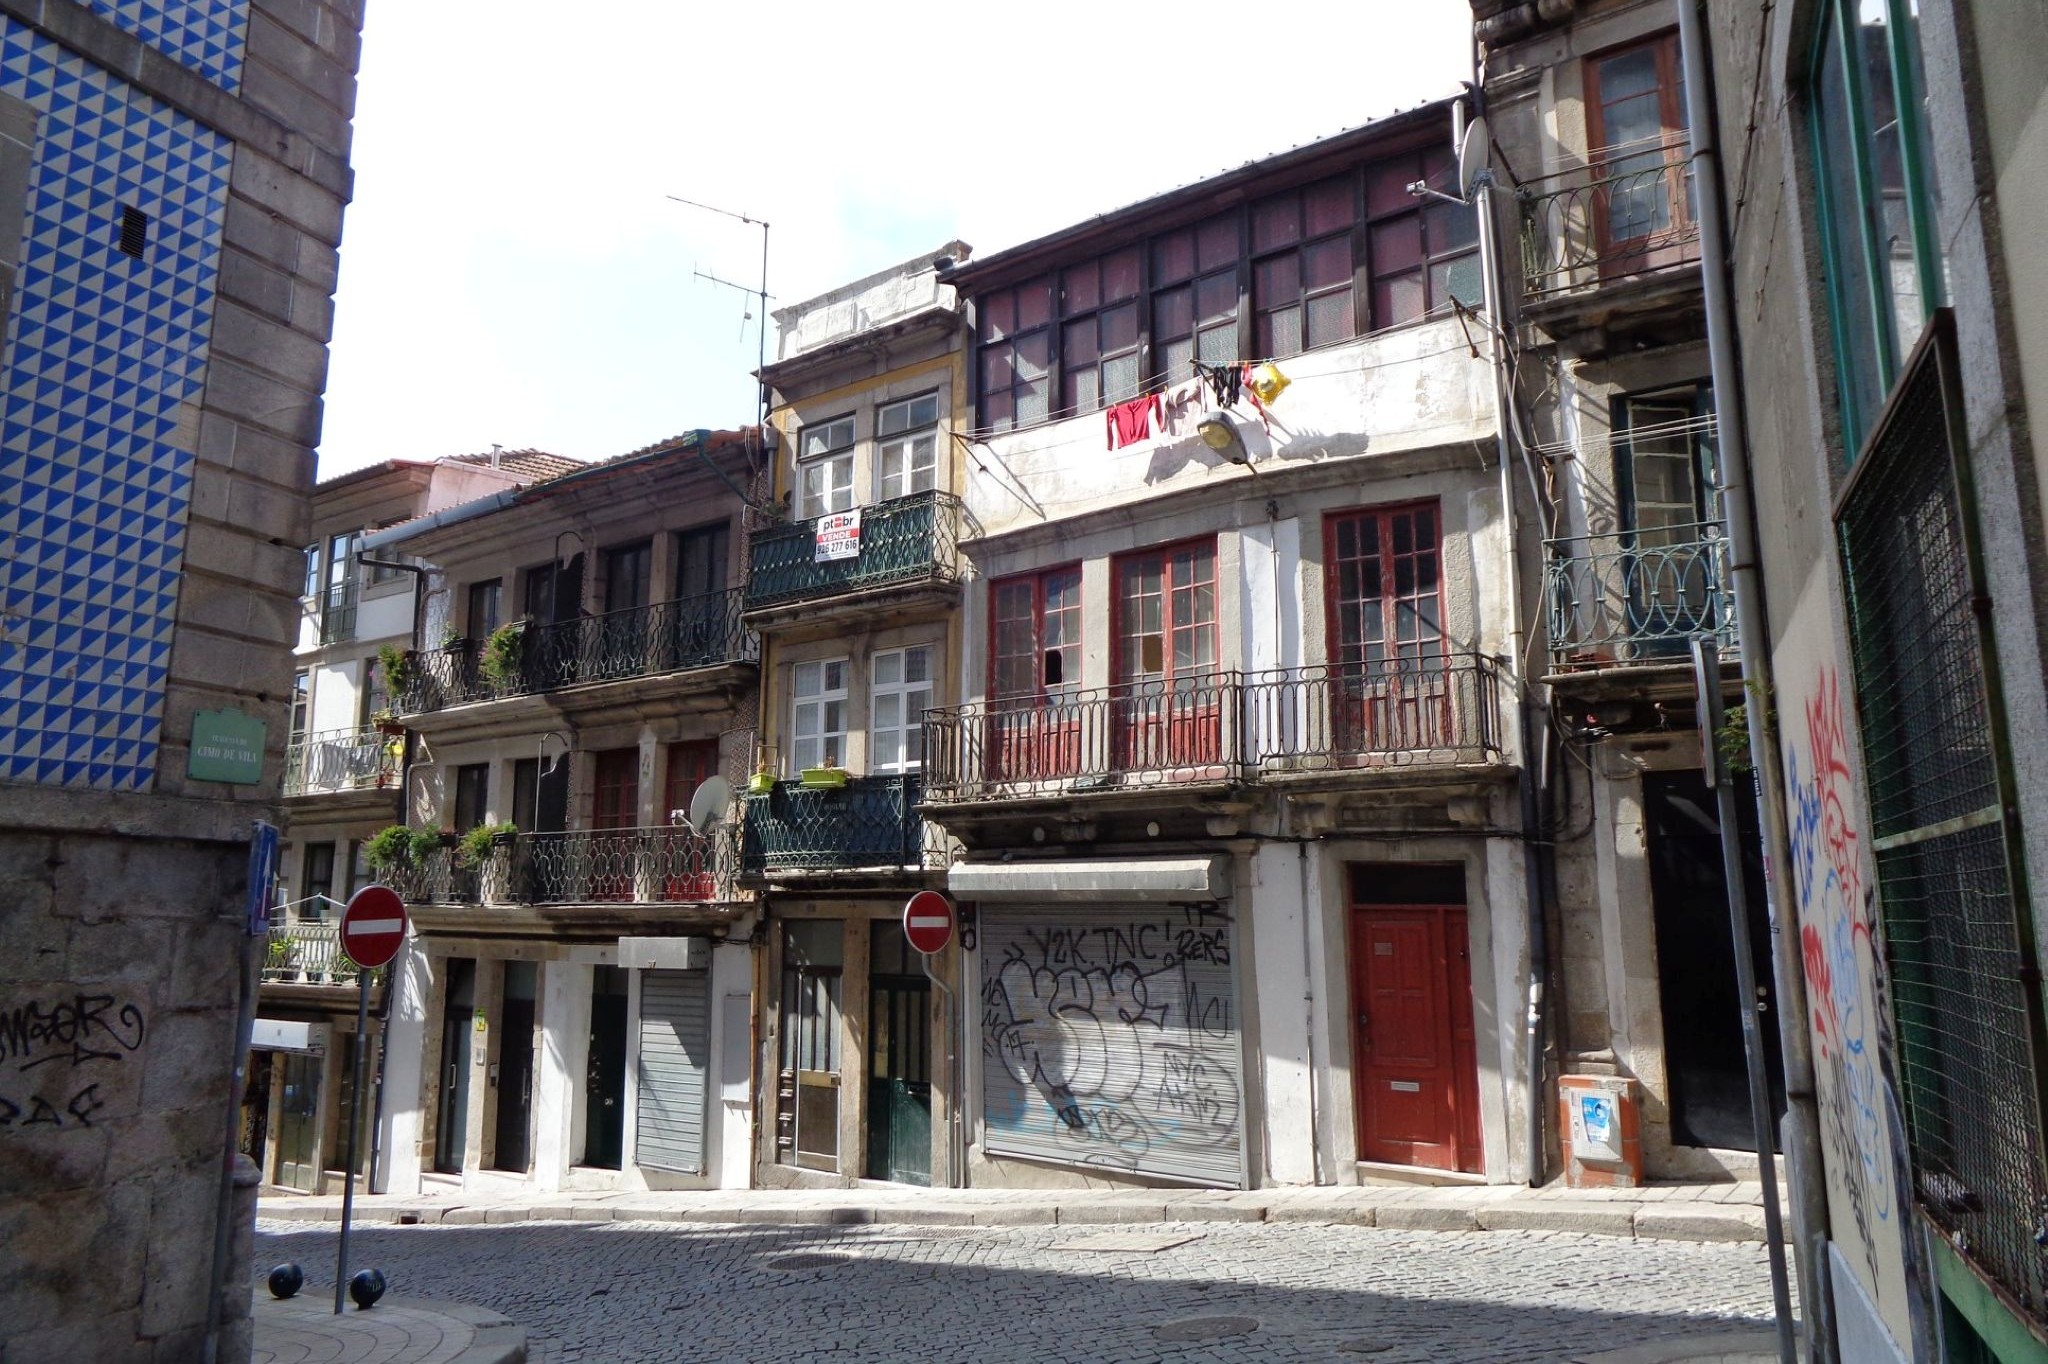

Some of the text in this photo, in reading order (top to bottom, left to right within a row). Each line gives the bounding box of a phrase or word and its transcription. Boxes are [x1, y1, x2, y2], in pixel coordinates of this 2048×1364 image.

[821, 530, 851, 542] VENDE
[831, 541, 843, 552] 277
[845, 539, 857, 550] 616
